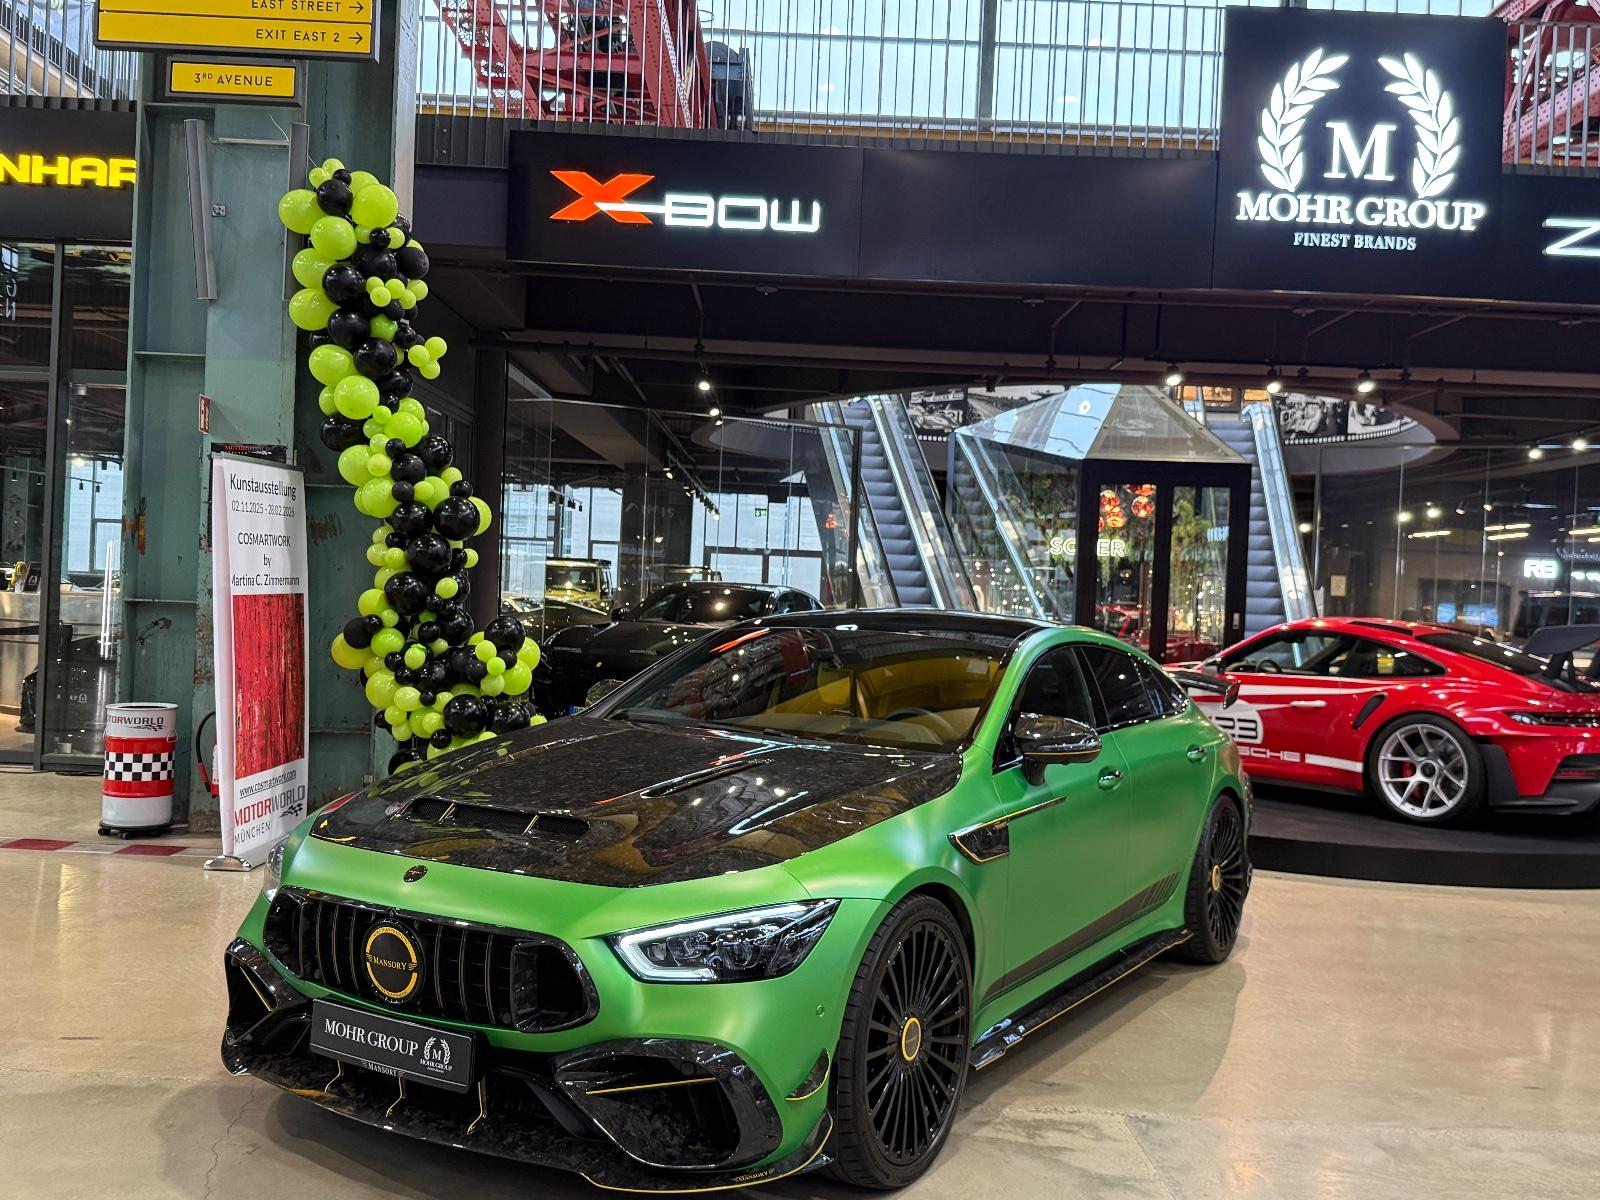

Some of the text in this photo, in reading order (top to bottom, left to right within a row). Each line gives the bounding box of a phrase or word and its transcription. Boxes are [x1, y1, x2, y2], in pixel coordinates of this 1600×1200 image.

[252, 0, 341, 13] EAST STREET
[256, 28, 340, 43] EXIT EAST 2
[194, 72, 273, 87] 3RD AVENUE
[1323, 121, 1398, 182] M
[1236, 192, 1486, 231] MOHR GROUP
[1293, 232, 1417, 251] FINEST BRANDS
[230, 473, 297, 501] Kunstausstellung
[231, 500, 264, 514] 02.11.2025
[237, 532, 291, 547] COSMARTWORK
[263, 553, 271, 568] by
[255, 573, 263, 586] C.
[263, 573, 300, 587] Zimmermann
[234, 785, 306, 827] MOTORWORLD
[234, 821, 271, 845] MÜNCHEN
[373, 955, 407, 970] MANSORY
[324, 1018, 419, 1056] MOHR GROUP
[432, 1048, 442, 1061] M
[367, 1062, 398, 1077] MANSORY
